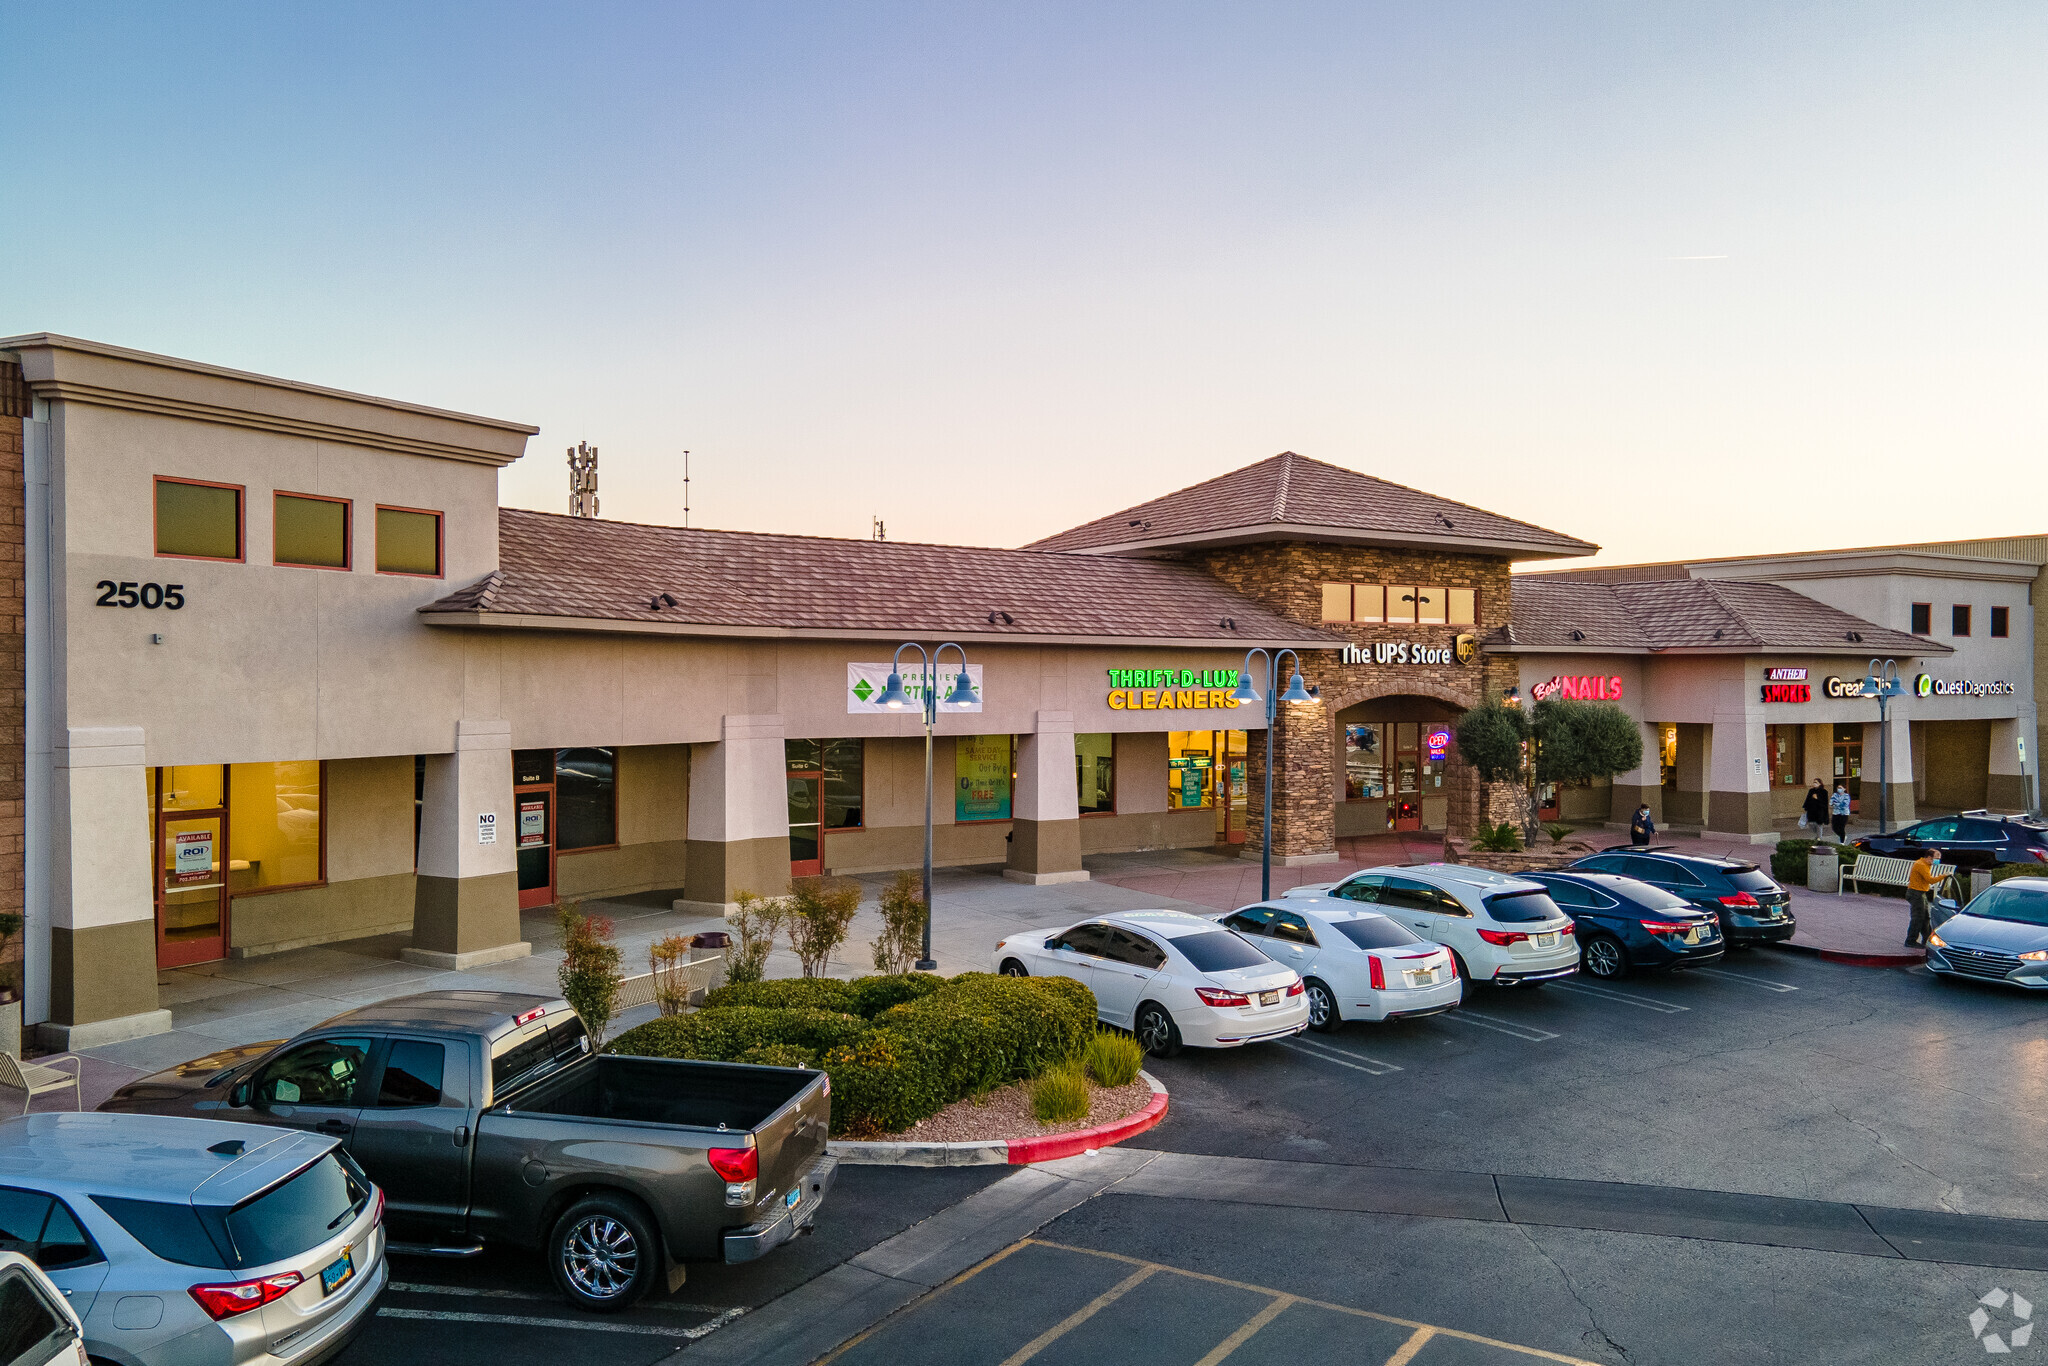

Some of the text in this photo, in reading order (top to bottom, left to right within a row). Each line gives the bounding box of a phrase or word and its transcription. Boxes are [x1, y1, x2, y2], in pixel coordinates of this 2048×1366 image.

[96, 580, 185, 610] 2505
[1343, 643, 1451, 664] The UPS Store
[1459, 642, 1474, 660] ups
[1769, 668, 1807, 680] ANTHEM
[1534, 675, 1623, 700] Best NAILS
[1765, 684, 1811, 702] SMOKES
[1828, 677, 1865, 697] Great
[1935, 679, 1964, 695] Quest
[1964, 679, 2015, 697] Diagnostics
[1108, 690, 1240, 710] CLEANERS
[1429, 735, 1446, 746] OPEN
[965, 746, 1002, 754] SAME DAY
[969, 753, 997, 761] SERVICE
[972, 789, 995, 800] FREE
[480, 814, 495, 824] NO
[178, 833, 211, 843] AVAILABLE
[183, 847, 204, 856] ROI
